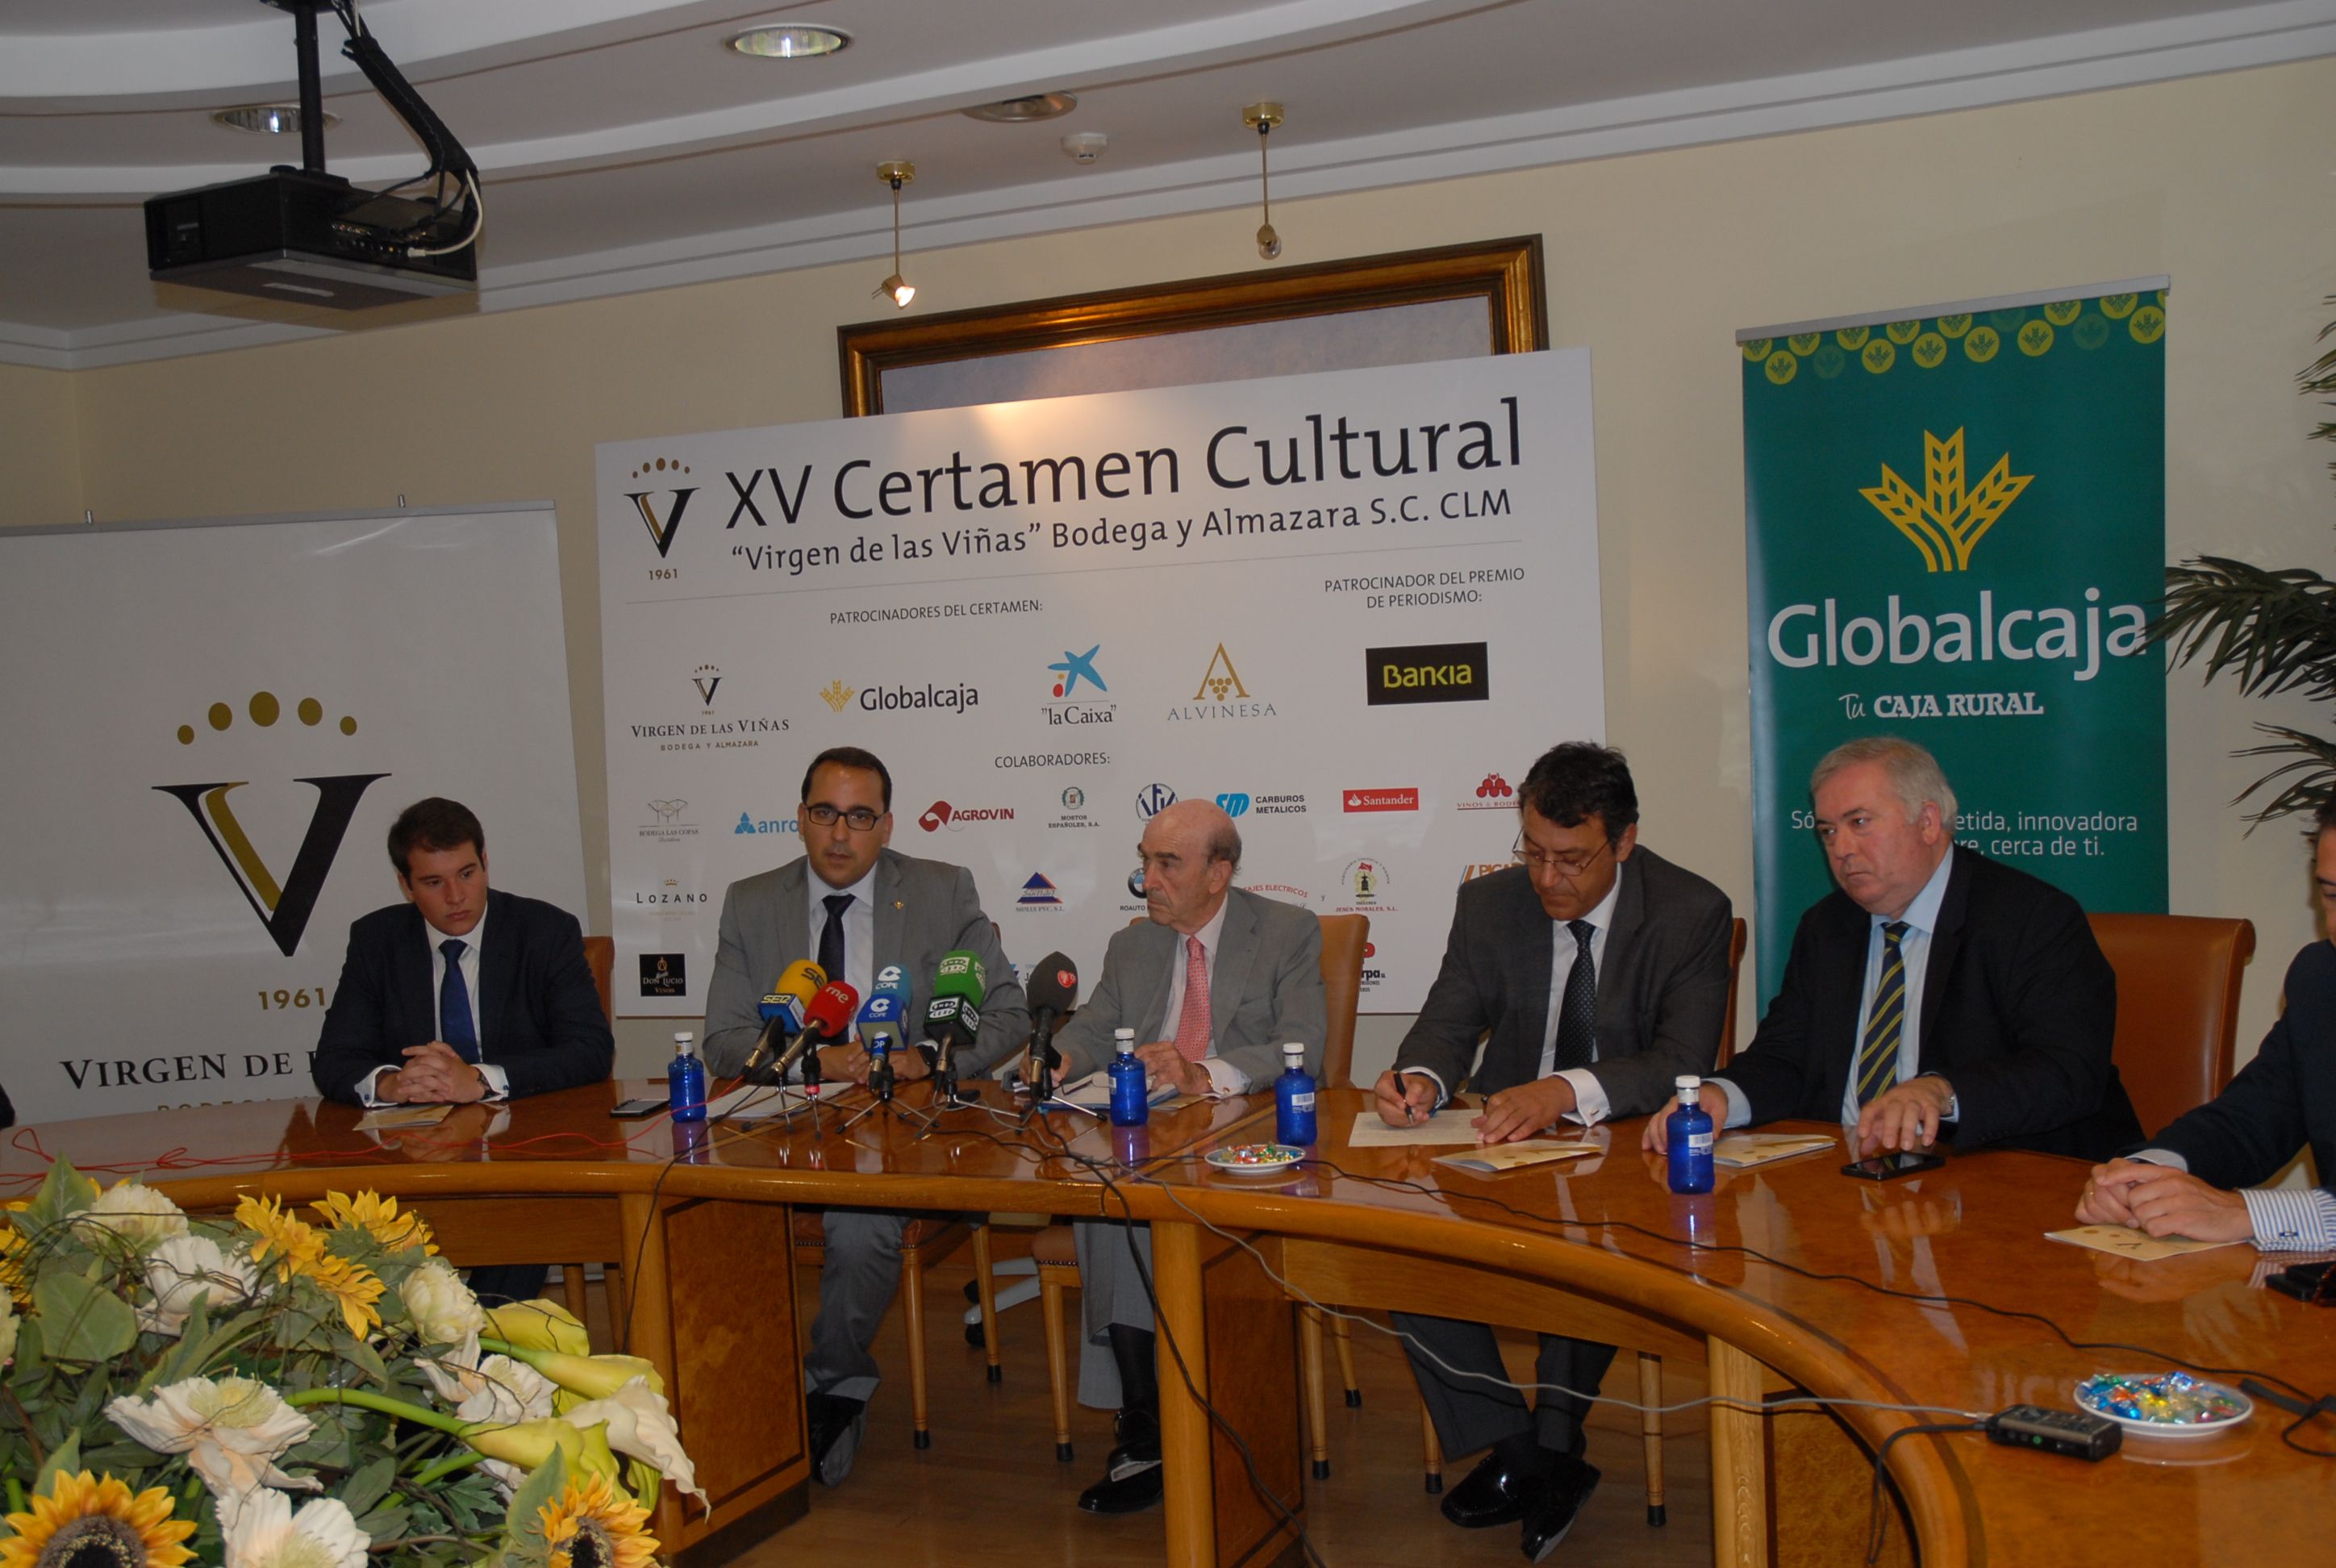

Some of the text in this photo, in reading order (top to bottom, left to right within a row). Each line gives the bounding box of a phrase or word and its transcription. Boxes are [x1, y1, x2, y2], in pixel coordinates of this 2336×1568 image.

[725, 396, 1521, 529] XV Certamen Cultural
[849, 536, 883, 563] de
[892, 533, 932, 560] las
[1052, 517, 1167, 551] Bodega
[1176, 519, 1193, 547] y
[1202, 506, 1361, 538] Almazara
[1370, 496, 1429, 525] S.C.
[1440, 489, 1512, 519] CLM
[648, 568, 678, 581] 1961
[1324, 567, 1525, 593] PATROCINADOR DEL PREMIO
[1366, 590, 1483, 609] DE PERIODISMO:
[829, 599, 1044, 624] PATROCINADORES DEL CERTAMEN:
[1767, 588, 2148, 682] Globalcaja
[1383, 662, 1472, 688] Bankia
[860, 682, 979, 715] Globalcaja
[1838, 692, 2045, 720] Tu CAJA RURAL
[1167, 703, 1277, 721] ALVINESA
[631, 717, 790, 739] VIRGEN DE LAS VIÑAS
[660, 742, 701, 751] BODEGA
[715, 740, 759, 749] ALMAZARA
[995, 752, 1111, 769] COLABORADORES:
[1255, 794, 1305, 804] CARBUROS
[1363, 794, 1414, 806] Santander
[951, 808, 1014, 822] AGROVIN
[1256, 805, 1307, 814] METALICOS
[1955, 811, 2011, 833] etida,
[2017, 811, 2138, 832] innovadora
[1991, 840, 2044, 856] cerca
[2050, 837, 2076, 855] de
[2082, 838, 2104, 856] ti.
[636, 892, 707, 903] LOZANO
[1265, 884, 1308, 898] ELECTRICOS
[643, 977, 683, 987] DON LUCIO
[801, 967, 826, 988] SE
[875, 982, 898, 990] COPE
[258, 986, 326, 1011] 1961
[761, 995, 791, 1004] SER
[825, 986, 849, 1004] rne
[60, 1053, 227, 1090] VIRGEN
[244, 1052, 294, 1077] DE
